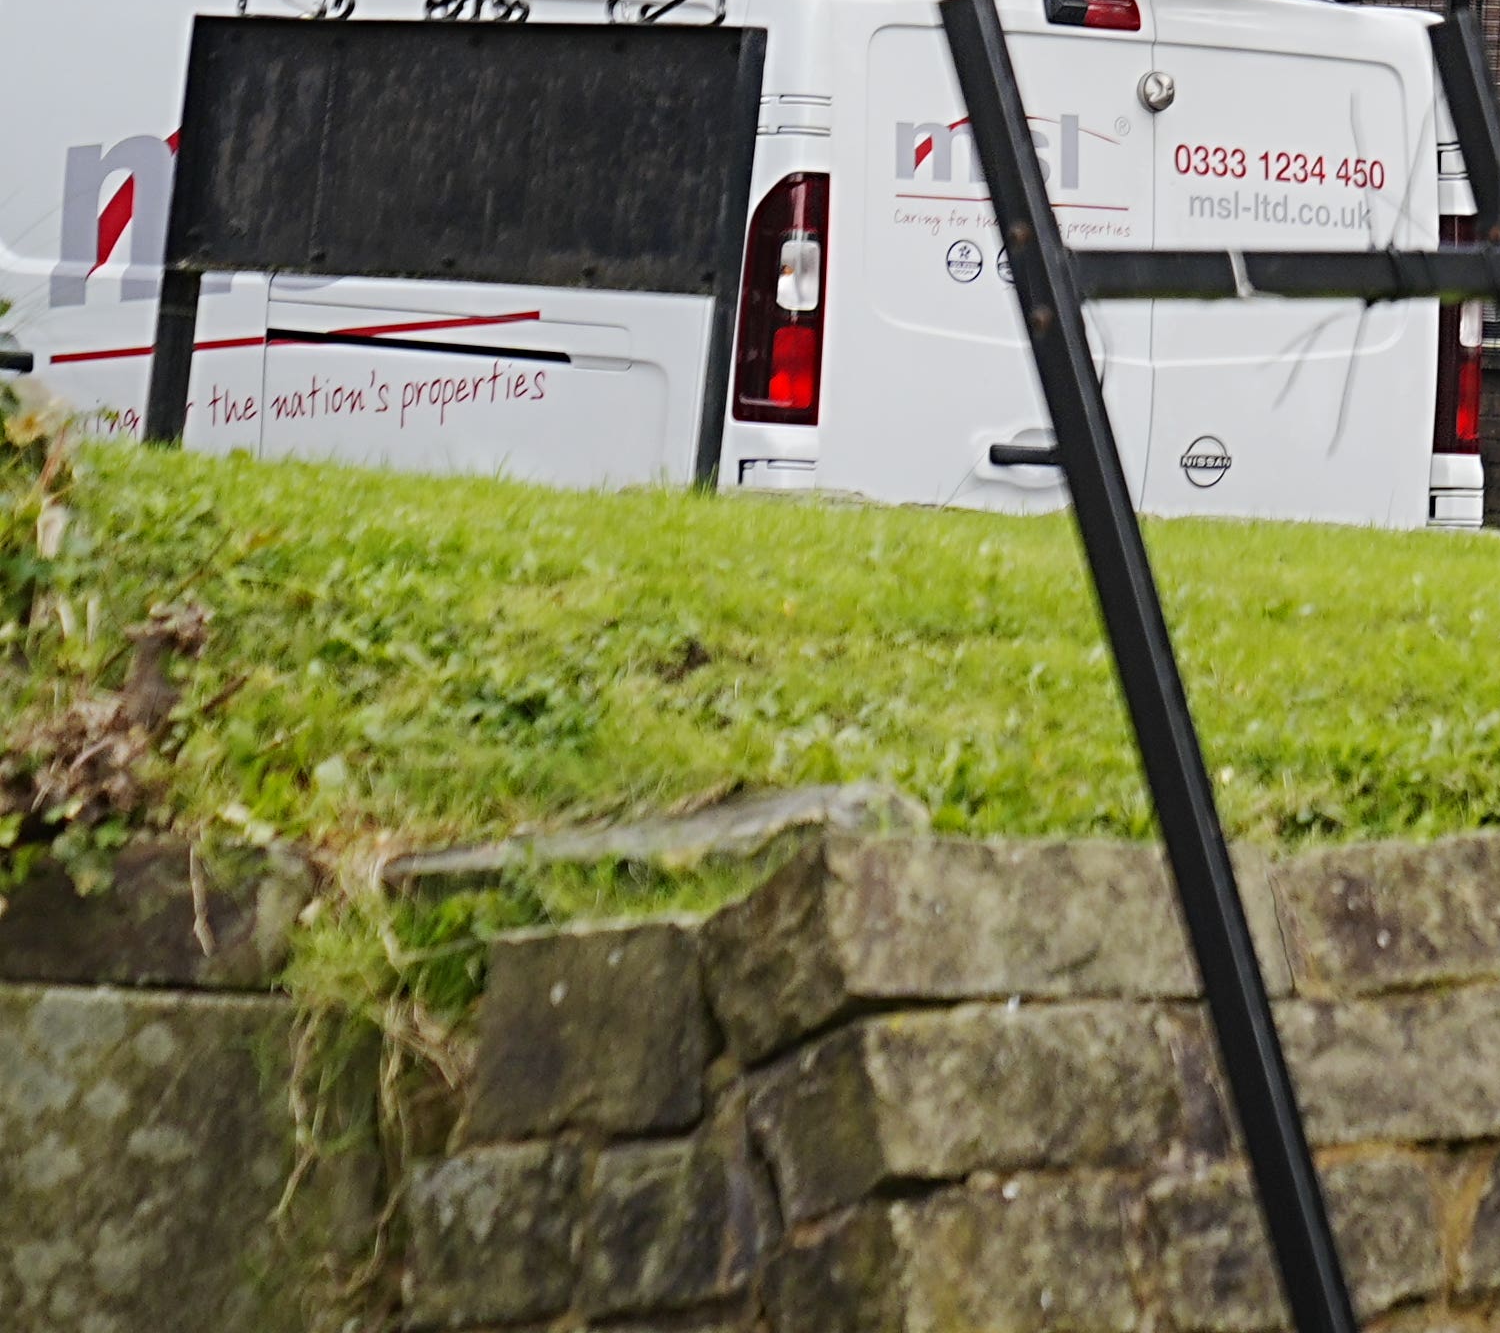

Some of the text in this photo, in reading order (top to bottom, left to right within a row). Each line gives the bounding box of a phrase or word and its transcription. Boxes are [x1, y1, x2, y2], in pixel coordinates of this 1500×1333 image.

[1174, 144, 1385, 190] 0333 1234 450
[948, 209, 968, 226] for
[1067, 221, 1131, 240] properties
[1189, 191, 1372, 230] msl-ltd.co.uk
[208, 384, 258, 426] the
[270, 369, 389, 421] nation's
[400, 360, 546, 429] properties
[1181, 455, 1231, 468] NISSAN
